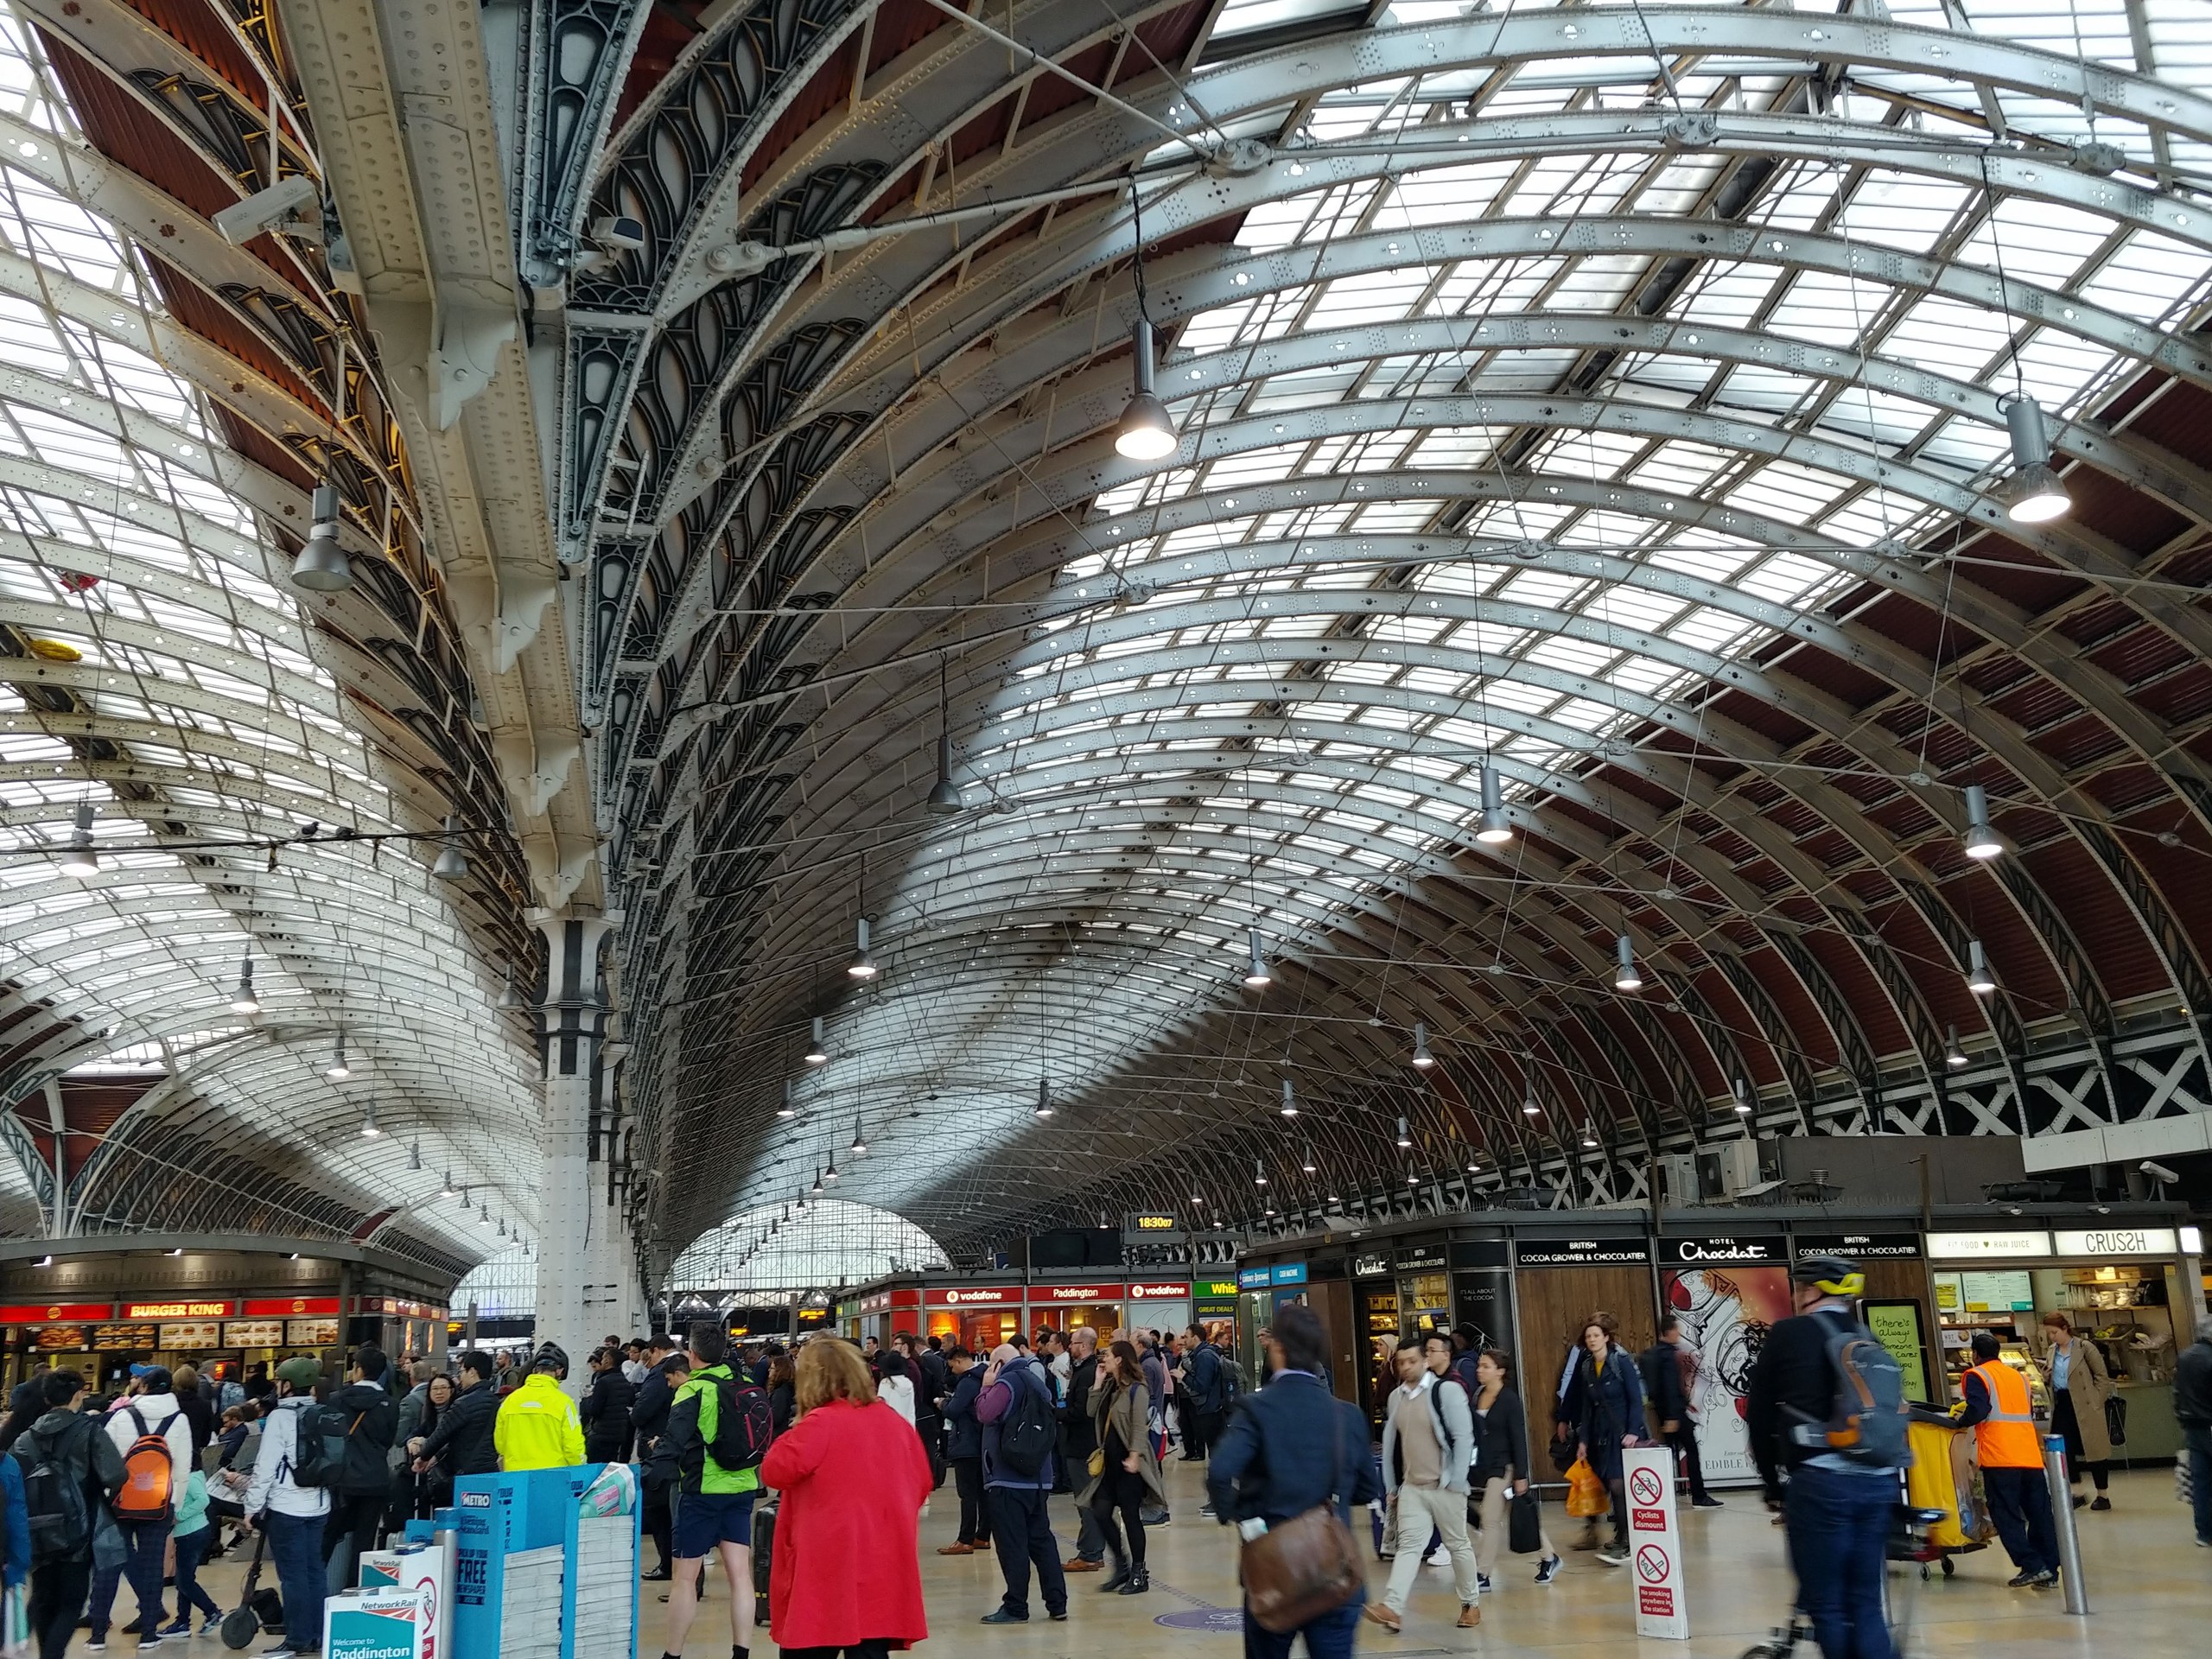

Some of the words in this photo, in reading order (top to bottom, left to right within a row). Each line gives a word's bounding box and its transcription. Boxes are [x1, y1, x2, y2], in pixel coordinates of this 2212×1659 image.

[2085, 1232, 2147, 1252] CRUSSH
[1521, 1254, 1550, 1262] COCOA
[1551, 1253, 1585, 1262] GROWER
[1593, 1252, 1646, 1261] CHOCOLATIER
[1053, 1288, 1098, 1299] Paddington
[1145, 1285, 1185, 1295] vodafone
[1211, 1283, 1239, 1294] Whis
[960, 1291, 1002, 1300] vodafone
[130, 1305, 187, 1317] BURGER
[188, 1304, 224, 1315] KING
[1875, 1316, 1910, 1327] there's
[1705, 1459, 1743, 1470] EDIBLE
[463, 1494, 490, 1506] METRO
[1637, 1510, 1660, 1520] Cyclists
[1635, 1520, 1664, 1529] dismount
[458, 1559, 486, 1584] FREE
[332, 1646, 410, 1659] Paddington
